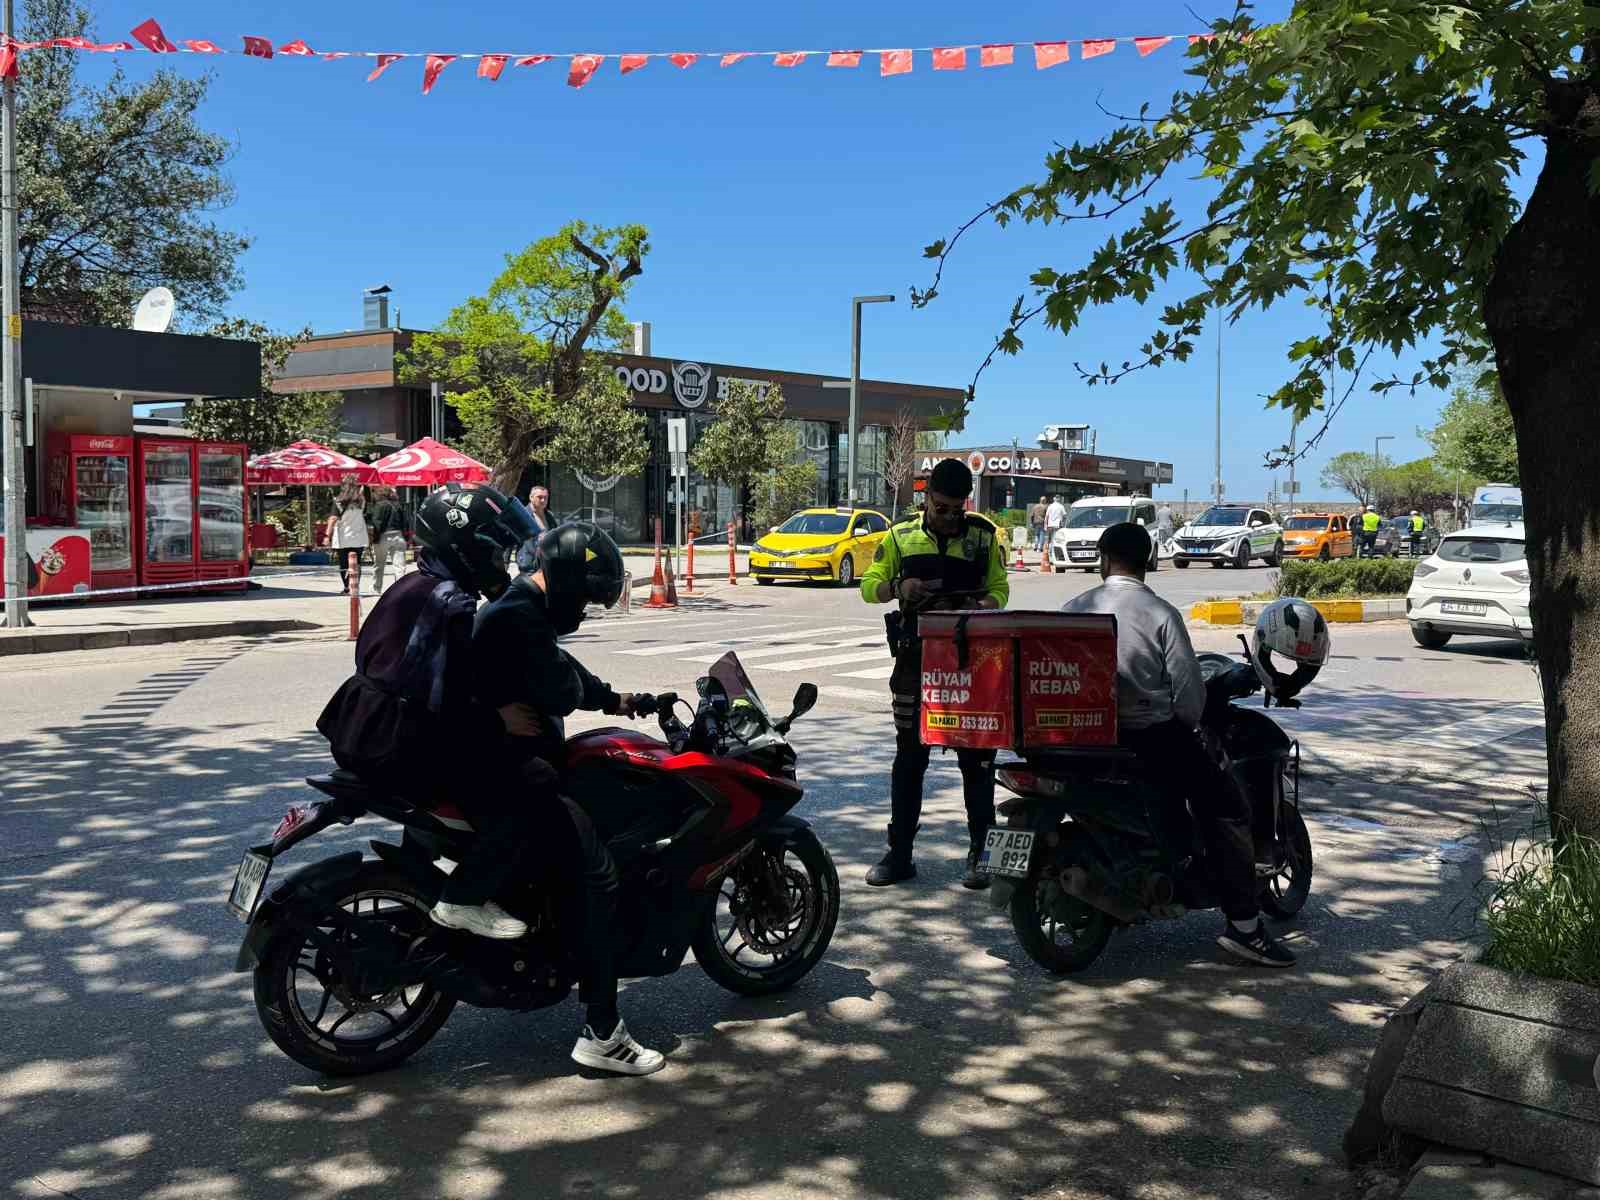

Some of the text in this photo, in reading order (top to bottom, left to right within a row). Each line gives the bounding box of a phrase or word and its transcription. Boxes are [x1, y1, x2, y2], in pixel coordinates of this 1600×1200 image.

[605, 365, 667, 394] OOD
[1029, 657, 1080, 676] RÜYAM
[922, 668, 972, 687] RÜYAM
[1029, 679, 1081, 695] KEBAP
[922, 688, 970, 704] KEBAP
[986, 831, 1032, 850] 67 AED
[1001, 850, 1028, 869] 892
